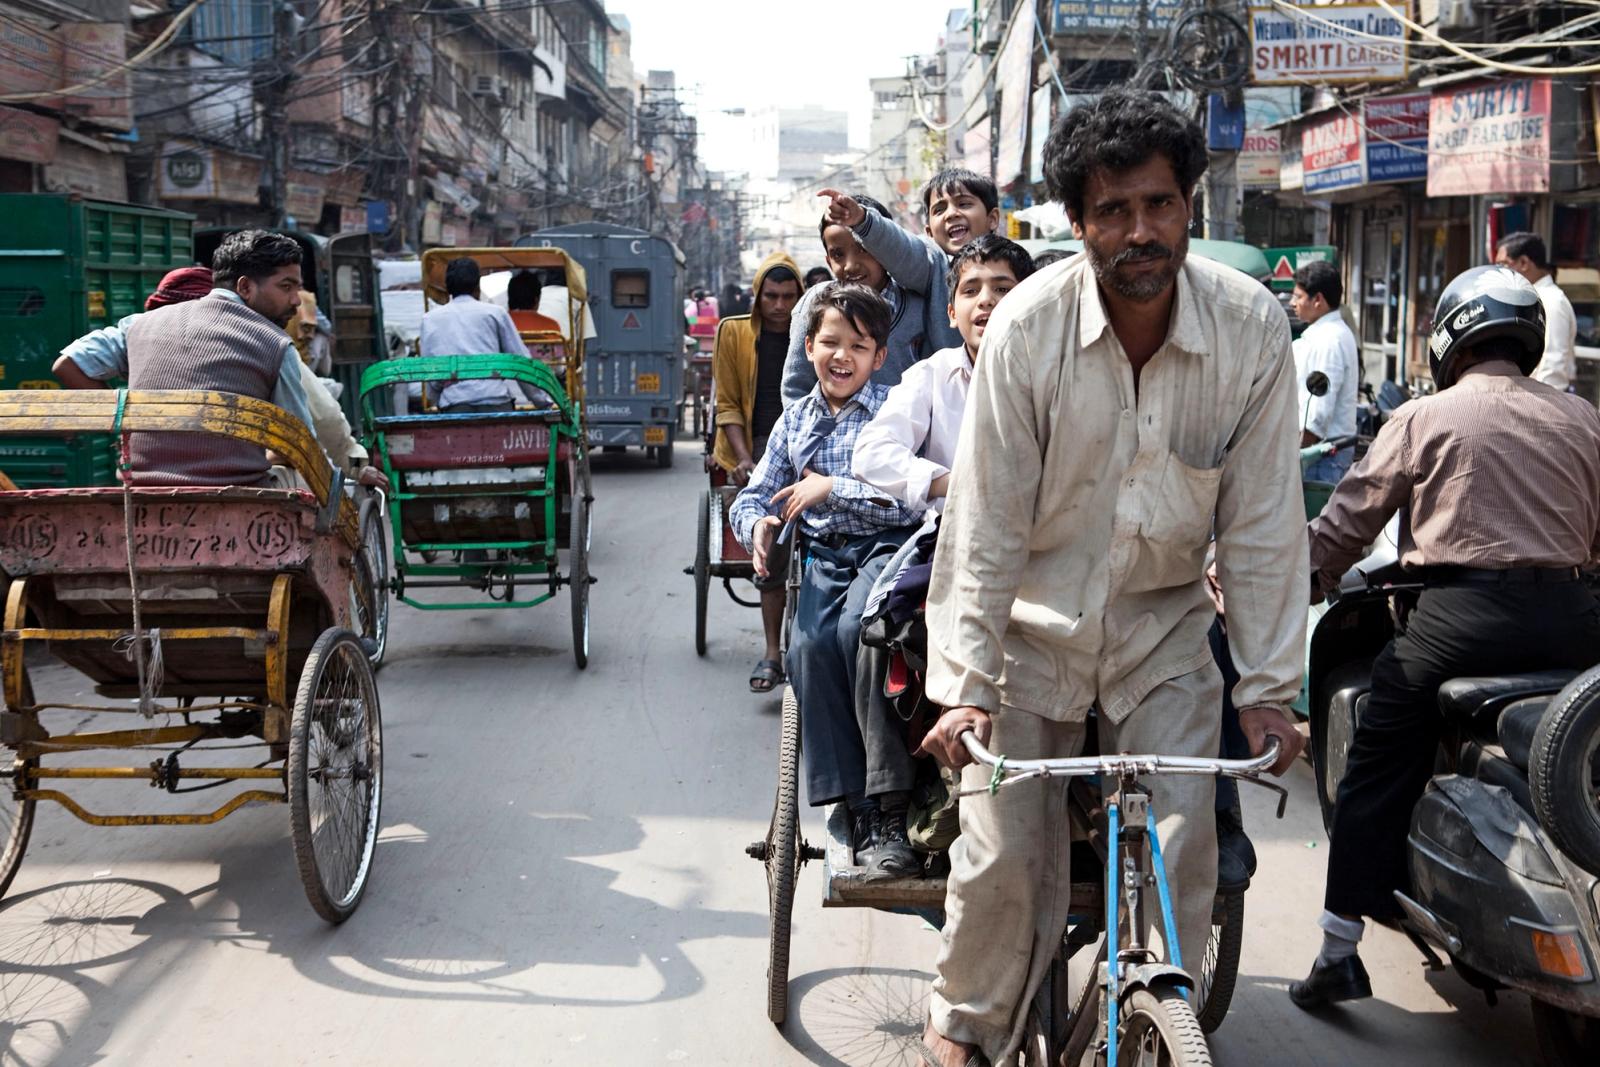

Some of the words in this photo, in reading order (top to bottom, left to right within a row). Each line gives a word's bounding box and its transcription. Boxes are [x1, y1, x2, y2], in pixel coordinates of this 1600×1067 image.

[1256, 44, 1342, 70] SMRITI
[1346, 45, 1401, 64] CARDS
[1451, 79, 1533, 123] SMRITI
